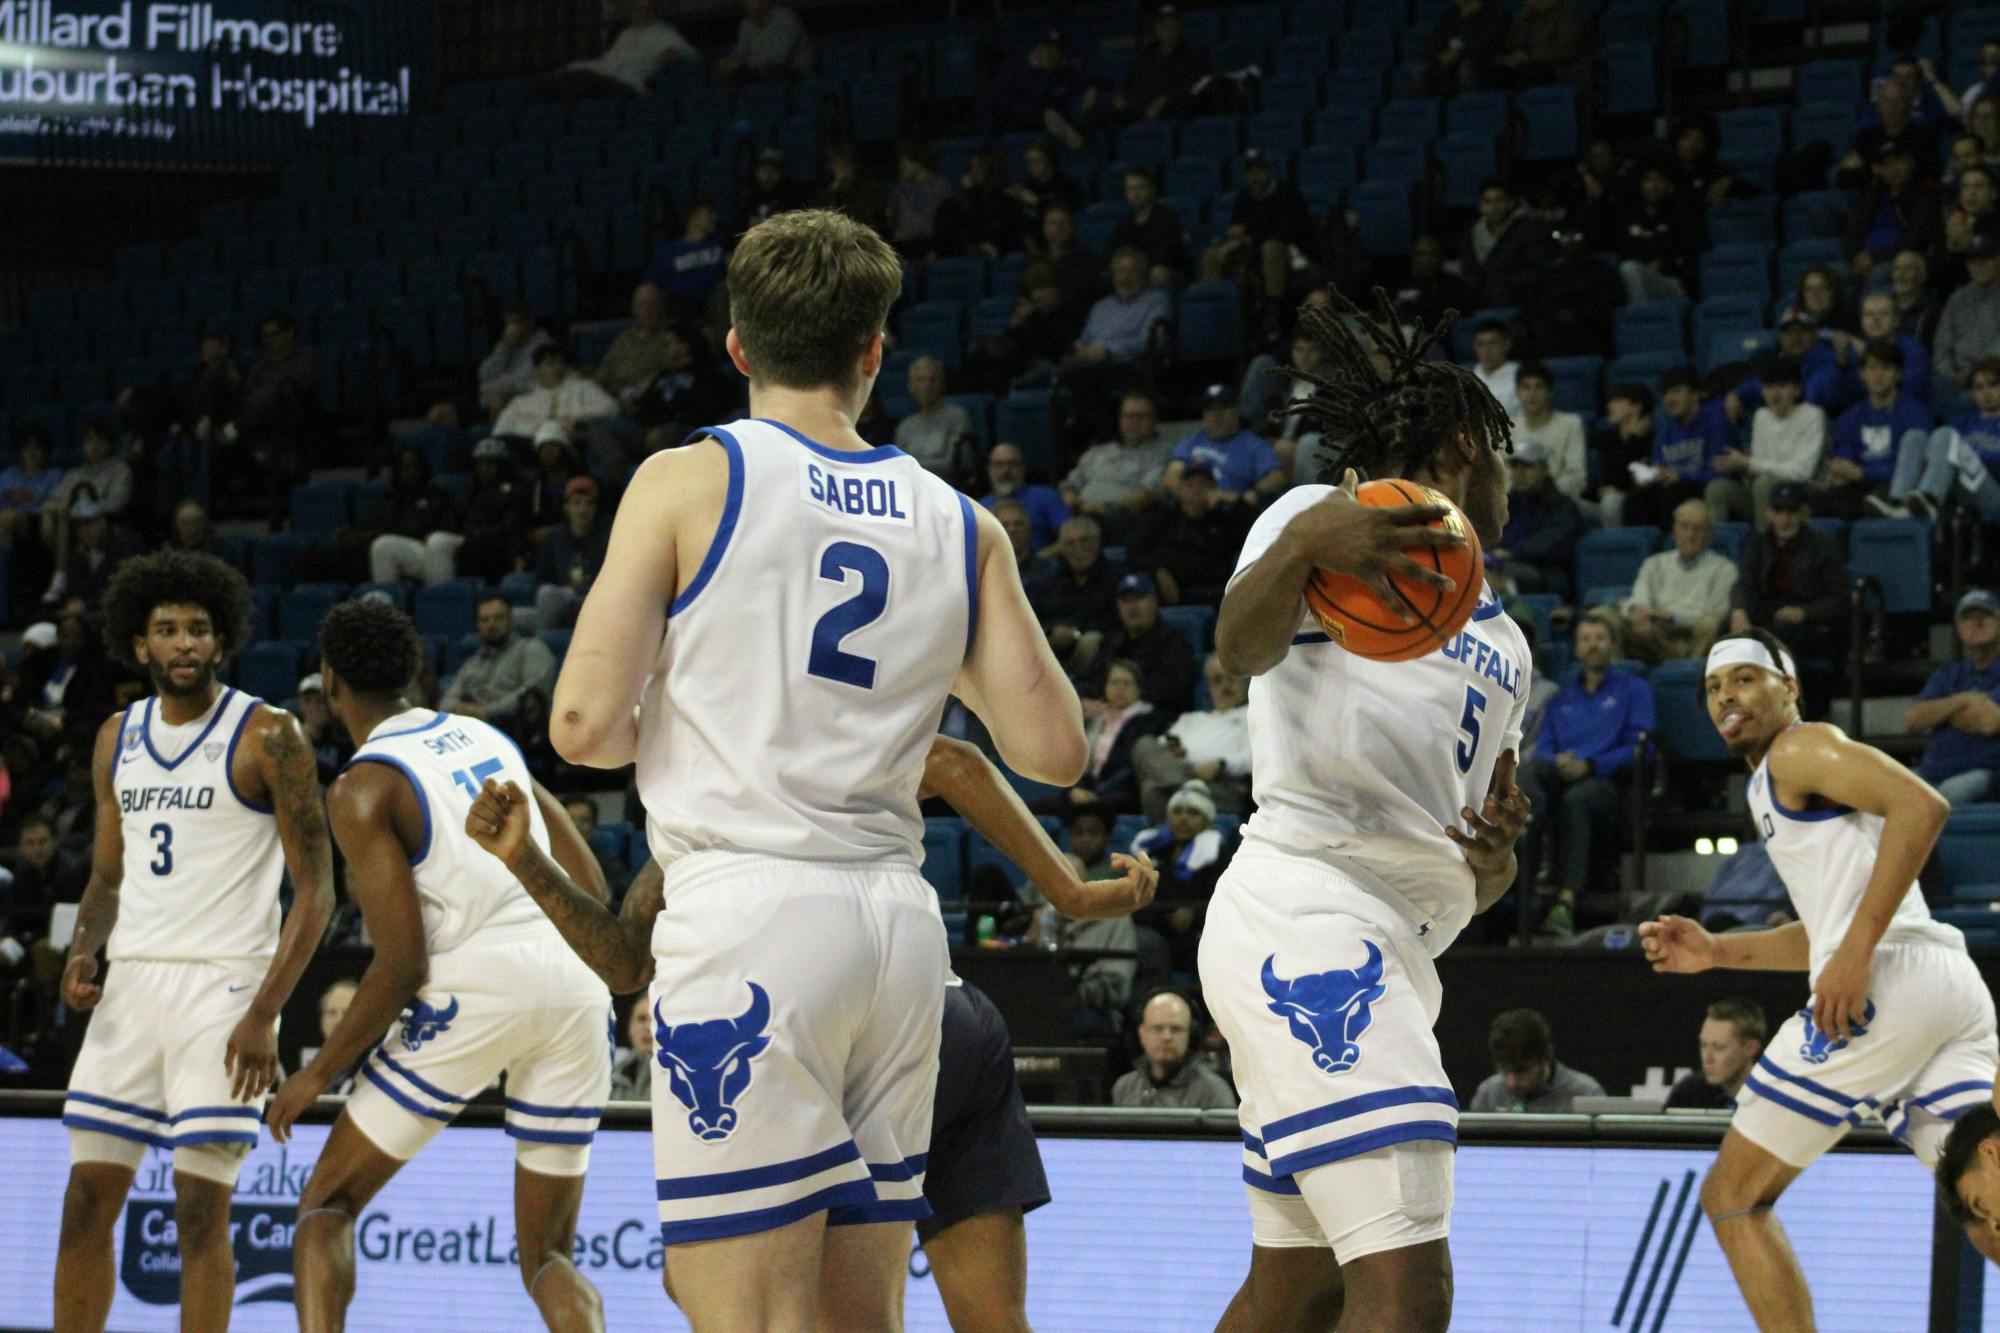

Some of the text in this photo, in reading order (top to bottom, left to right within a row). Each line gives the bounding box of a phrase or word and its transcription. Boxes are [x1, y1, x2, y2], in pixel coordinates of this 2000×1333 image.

[146, 2, 342, 57] Fillmore
[211, 61, 410, 129] Hospital
[808, 463, 906, 520] SABOL
[807, 540, 890, 691] 2
[1442, 630, 1521, 701] UFFALO
[1456, 683, 1487, 774] 5
[121, 786, 215, 813] BUFFALO
[149, 822, 173, 876] 3
